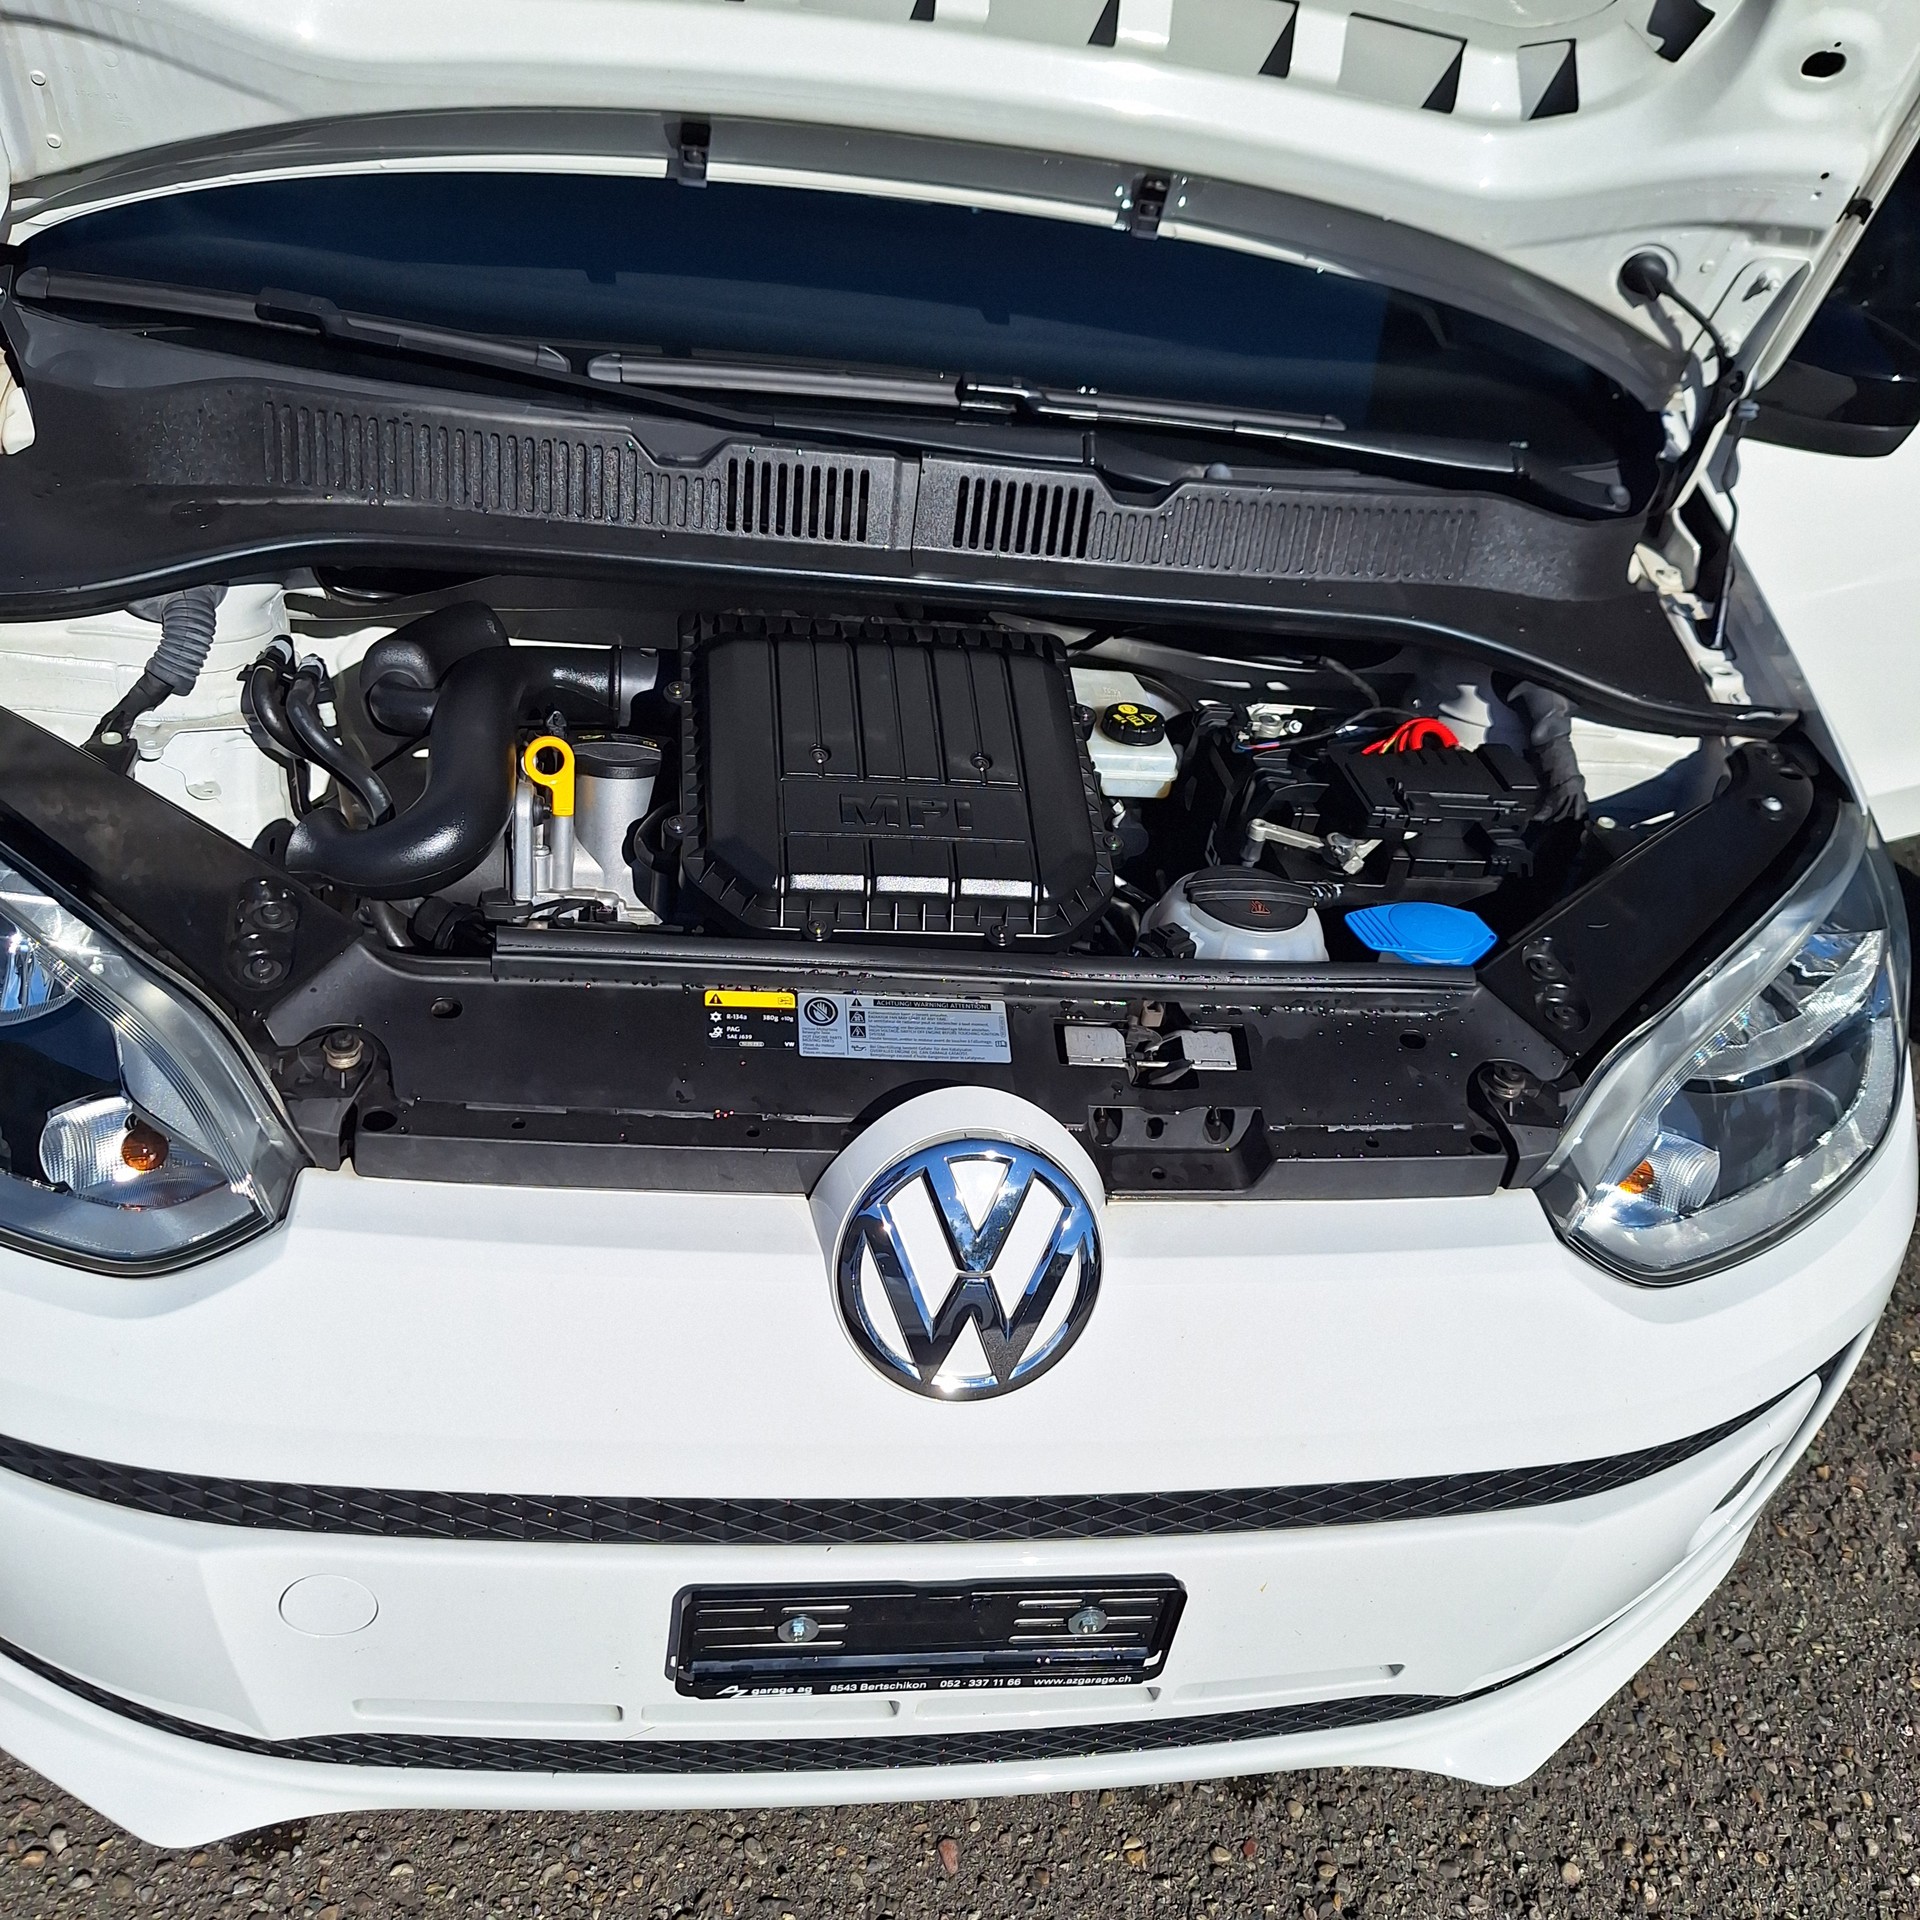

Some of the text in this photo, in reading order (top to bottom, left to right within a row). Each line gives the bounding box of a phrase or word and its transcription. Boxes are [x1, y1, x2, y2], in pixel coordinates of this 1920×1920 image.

[839, 793, 973, 830] MPI
[762, 1014, 779, 1023] 380g
[968, 1679, 989, 1687] 337
[1007, 1678, 1021, 1686] 66
[1034, 1675, 1132, 1685] www.azgarage.ch
[751, 1687, 794, 1695] garage
[797, 1686, 813, 1695] ag
[829, 1681, 927, 1692] 8543 Bertschikon
